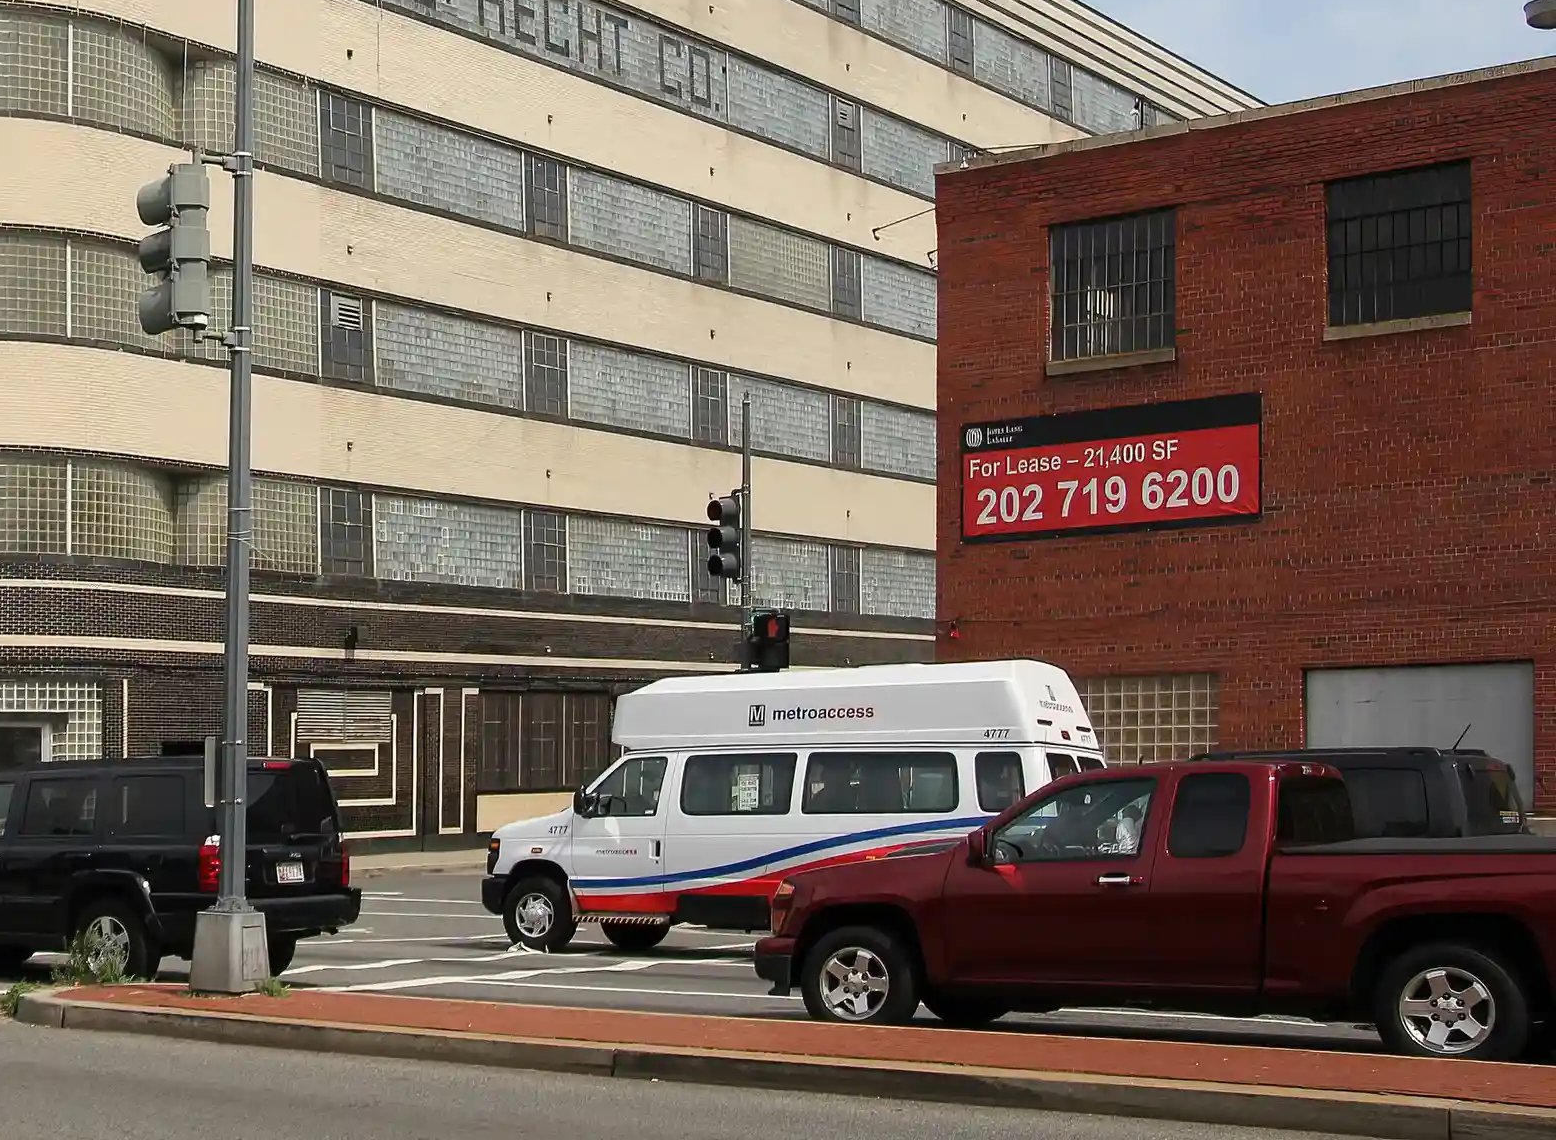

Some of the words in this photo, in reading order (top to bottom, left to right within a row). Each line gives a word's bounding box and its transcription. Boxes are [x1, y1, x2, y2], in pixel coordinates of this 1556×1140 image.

[969, 459, 1001, 479] For
[1006, 455, 1062, 475] Lease
[1084, 443, 1145, 469] 21,400
[1152, 439, 1179, 460] SF
[976, 483, 1044, 525] 202
[1057, 475, 1127, 518] 719
[1142, 464, 1239, 510] 6200
[772, 706, 875, 721] metroaccess
[984, 729, 1010, 739] 4777
[548, 825, 569, 835] 4777
